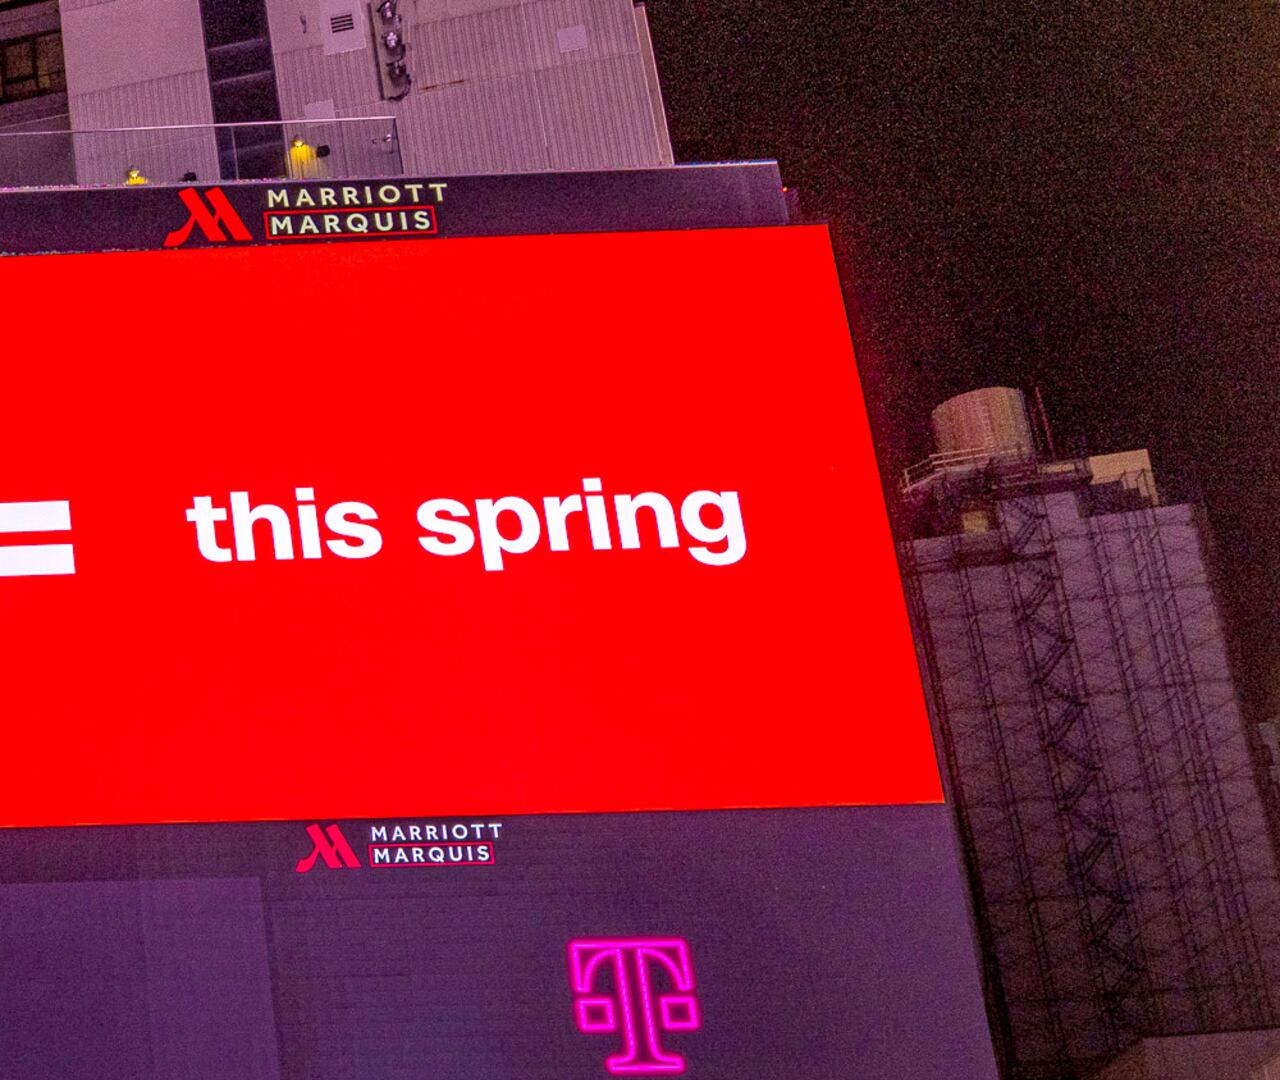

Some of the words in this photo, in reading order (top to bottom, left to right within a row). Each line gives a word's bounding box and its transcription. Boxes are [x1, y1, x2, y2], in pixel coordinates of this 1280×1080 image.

[267, 183, 448, 208] MARRIOTT
[270, 210, 430, 235] MARQUIS
[186, 488, 383, 561] this
[417, 478, 747, 570] spring
[371, 823, 503, 842] MARRIOTT
[373, 845, 490, 864] MARQUIS
